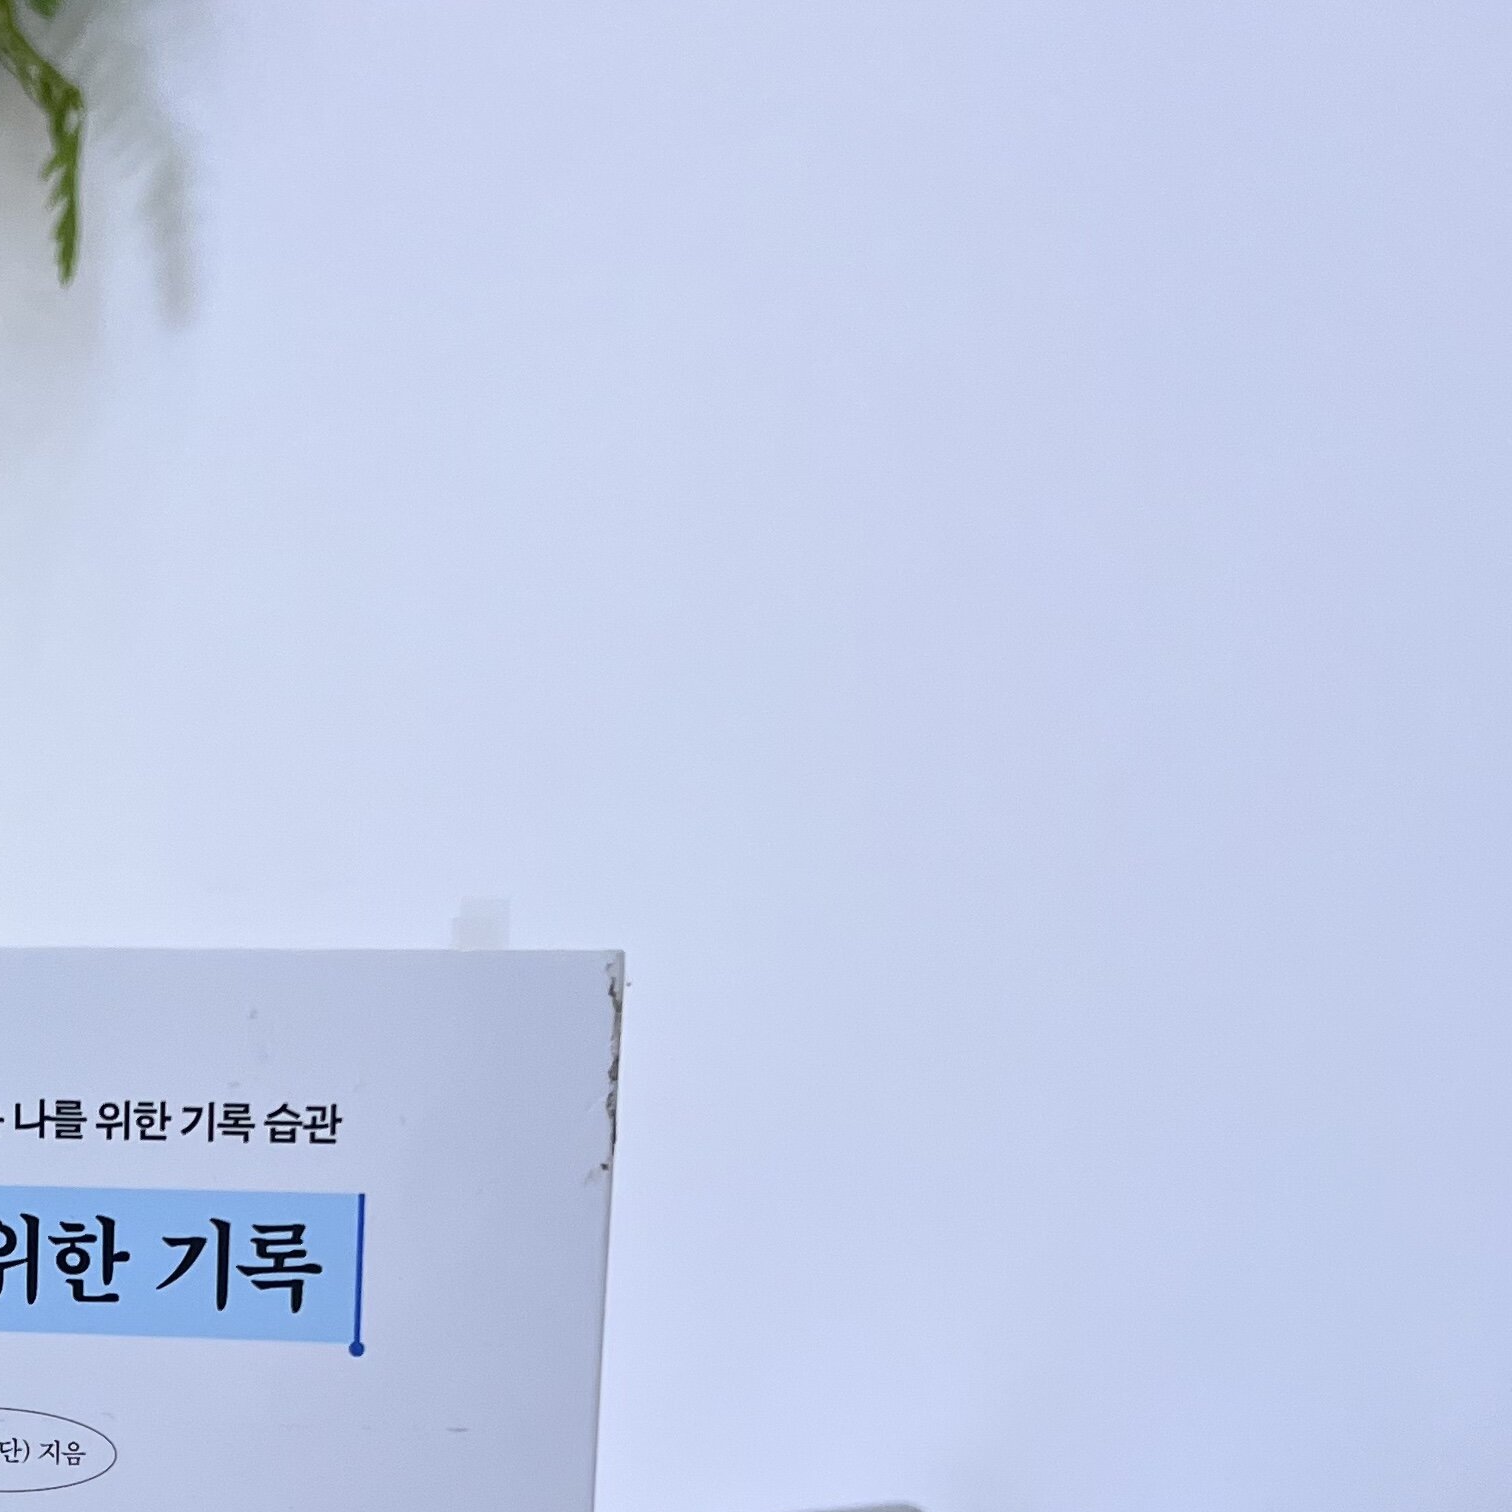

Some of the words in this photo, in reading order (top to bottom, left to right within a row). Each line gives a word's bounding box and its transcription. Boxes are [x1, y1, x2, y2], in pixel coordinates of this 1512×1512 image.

[14, 1098, 88, 1140] 나를
[95, 1100, 172, 1142] 위한
[180, 1101, 256, 1144] 기록
[263, 1103, 343, 1145] 습관
[155, 1217, 323, 1314] 기록
[37, 1439, 87, 1467] 지음
